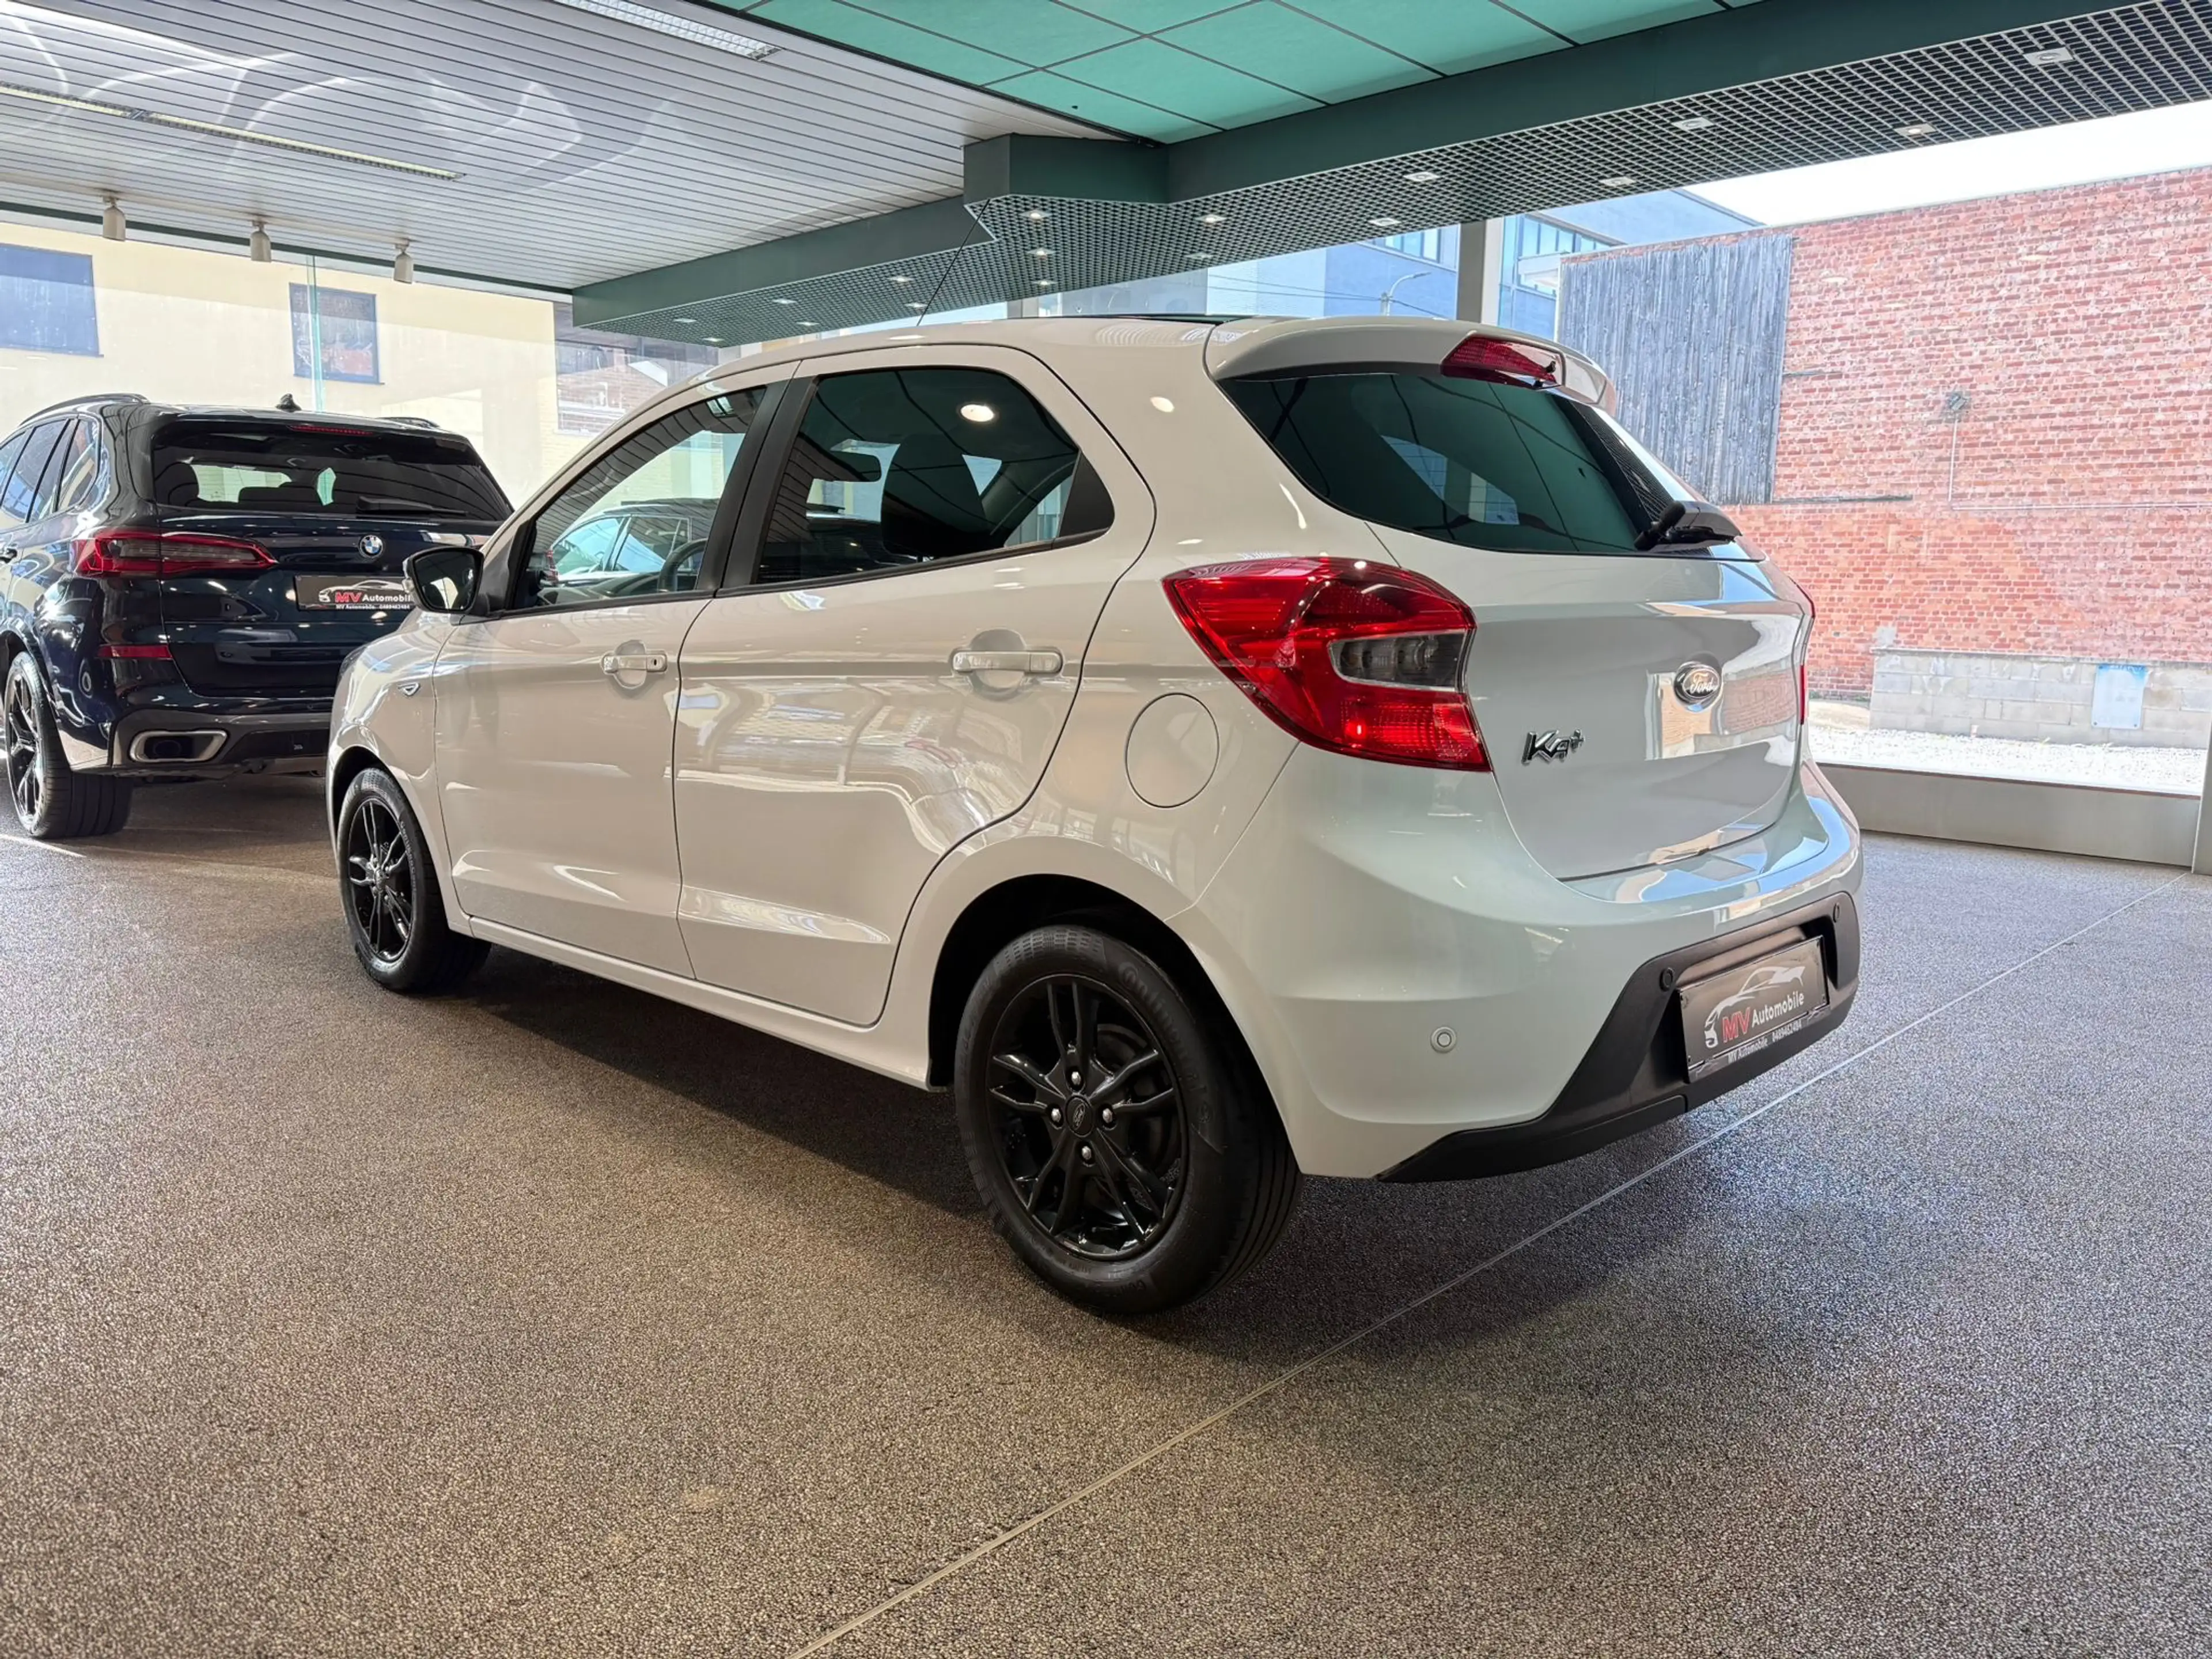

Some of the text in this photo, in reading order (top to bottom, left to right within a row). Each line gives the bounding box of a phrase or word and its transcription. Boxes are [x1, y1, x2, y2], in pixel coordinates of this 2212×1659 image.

[335, 591, 362, 603] MV
[1690, 672, 1719, 694] Ford
[1722, 991, 1805, 1043] MV Automobile
